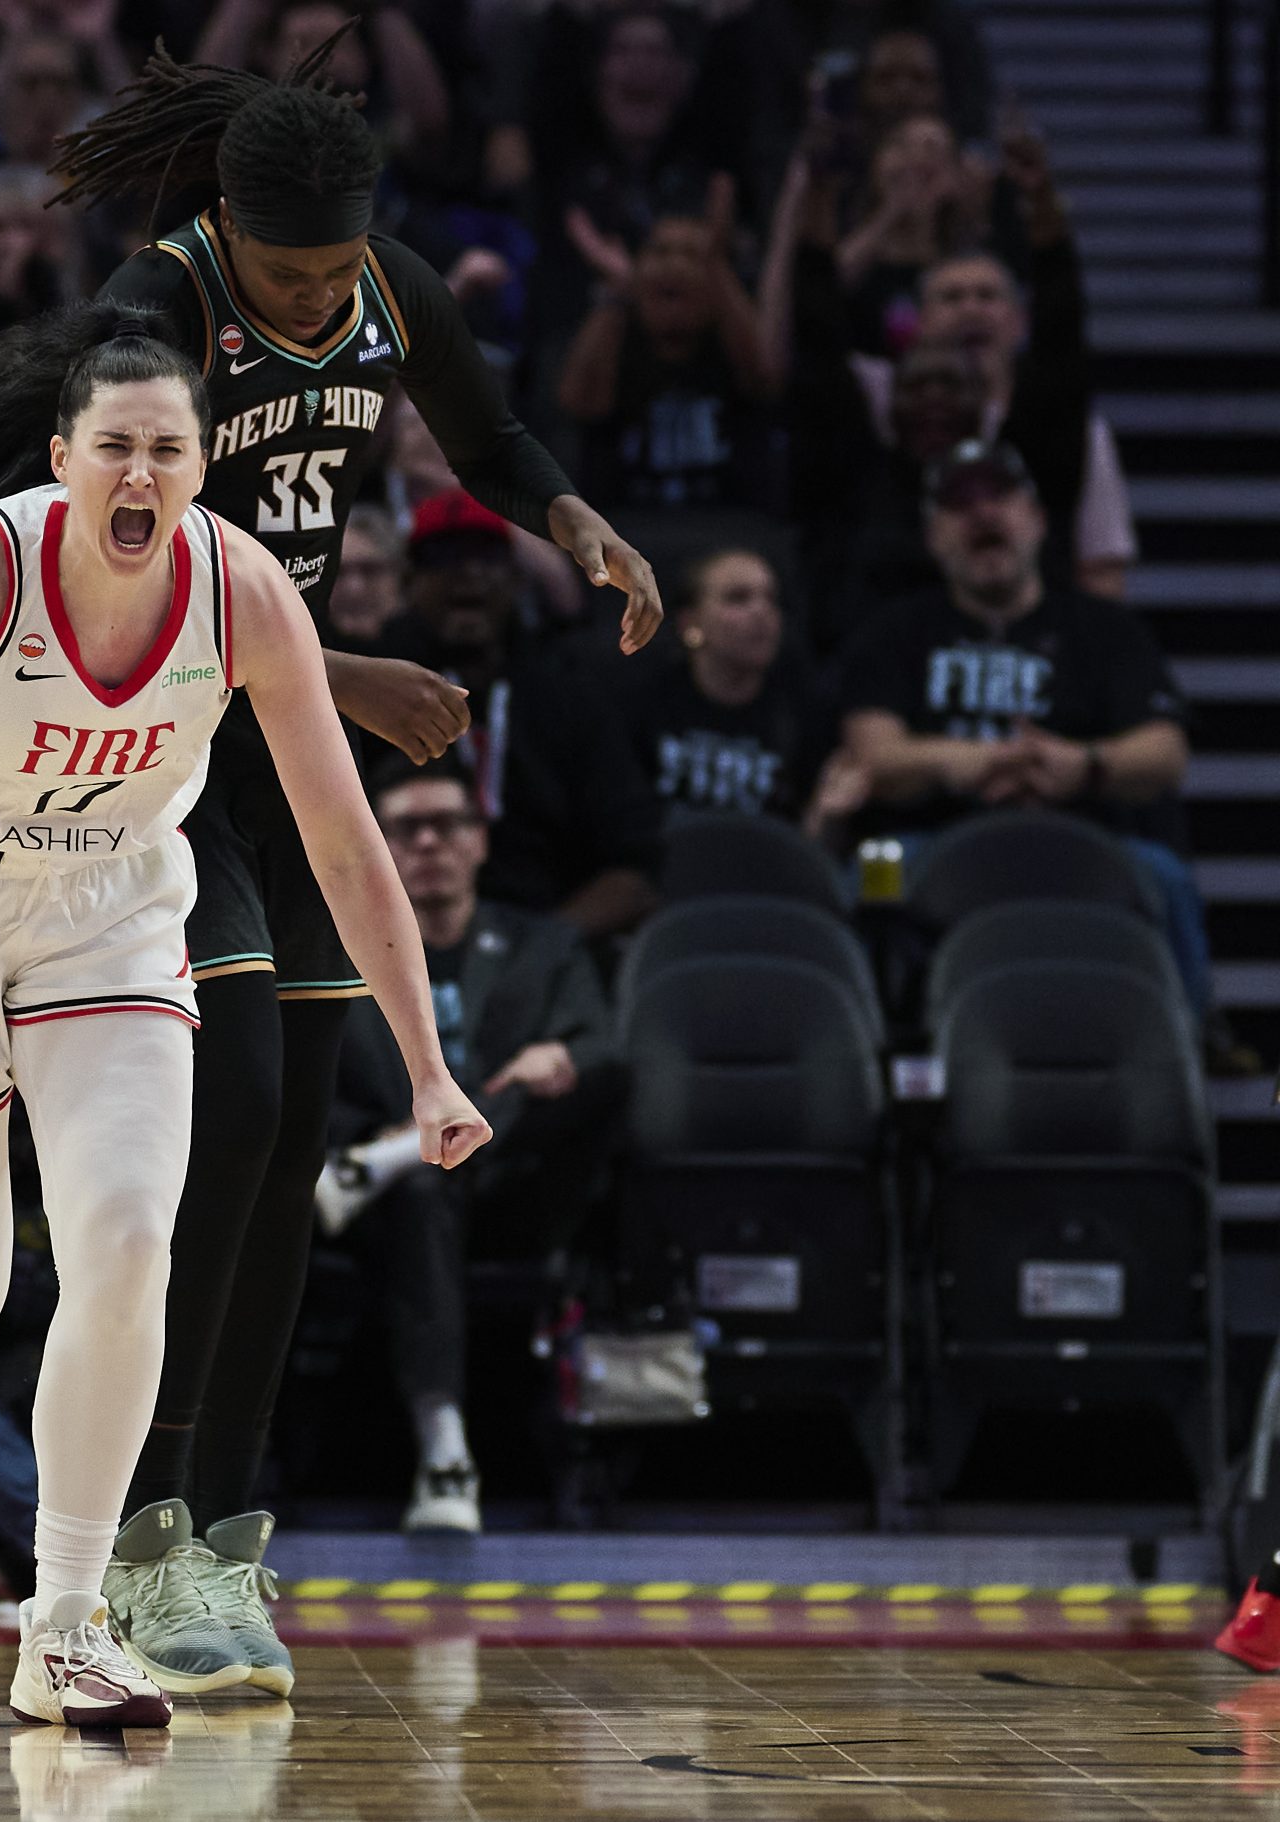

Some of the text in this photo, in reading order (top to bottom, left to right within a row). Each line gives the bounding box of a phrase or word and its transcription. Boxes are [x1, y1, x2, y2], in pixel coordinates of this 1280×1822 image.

[358, 342, 392, 362] BARCLAYS
[212, 394, 299, 463] NEW
[256, 447, 349, 533] 35
[284, 553, 329, 576] Liberty
[290, 567, 325, 592] utual
[161, 665, 217, 689] chime
[16, 720, 176, 777] FIRE
[19, 779, 126, 817] 17
